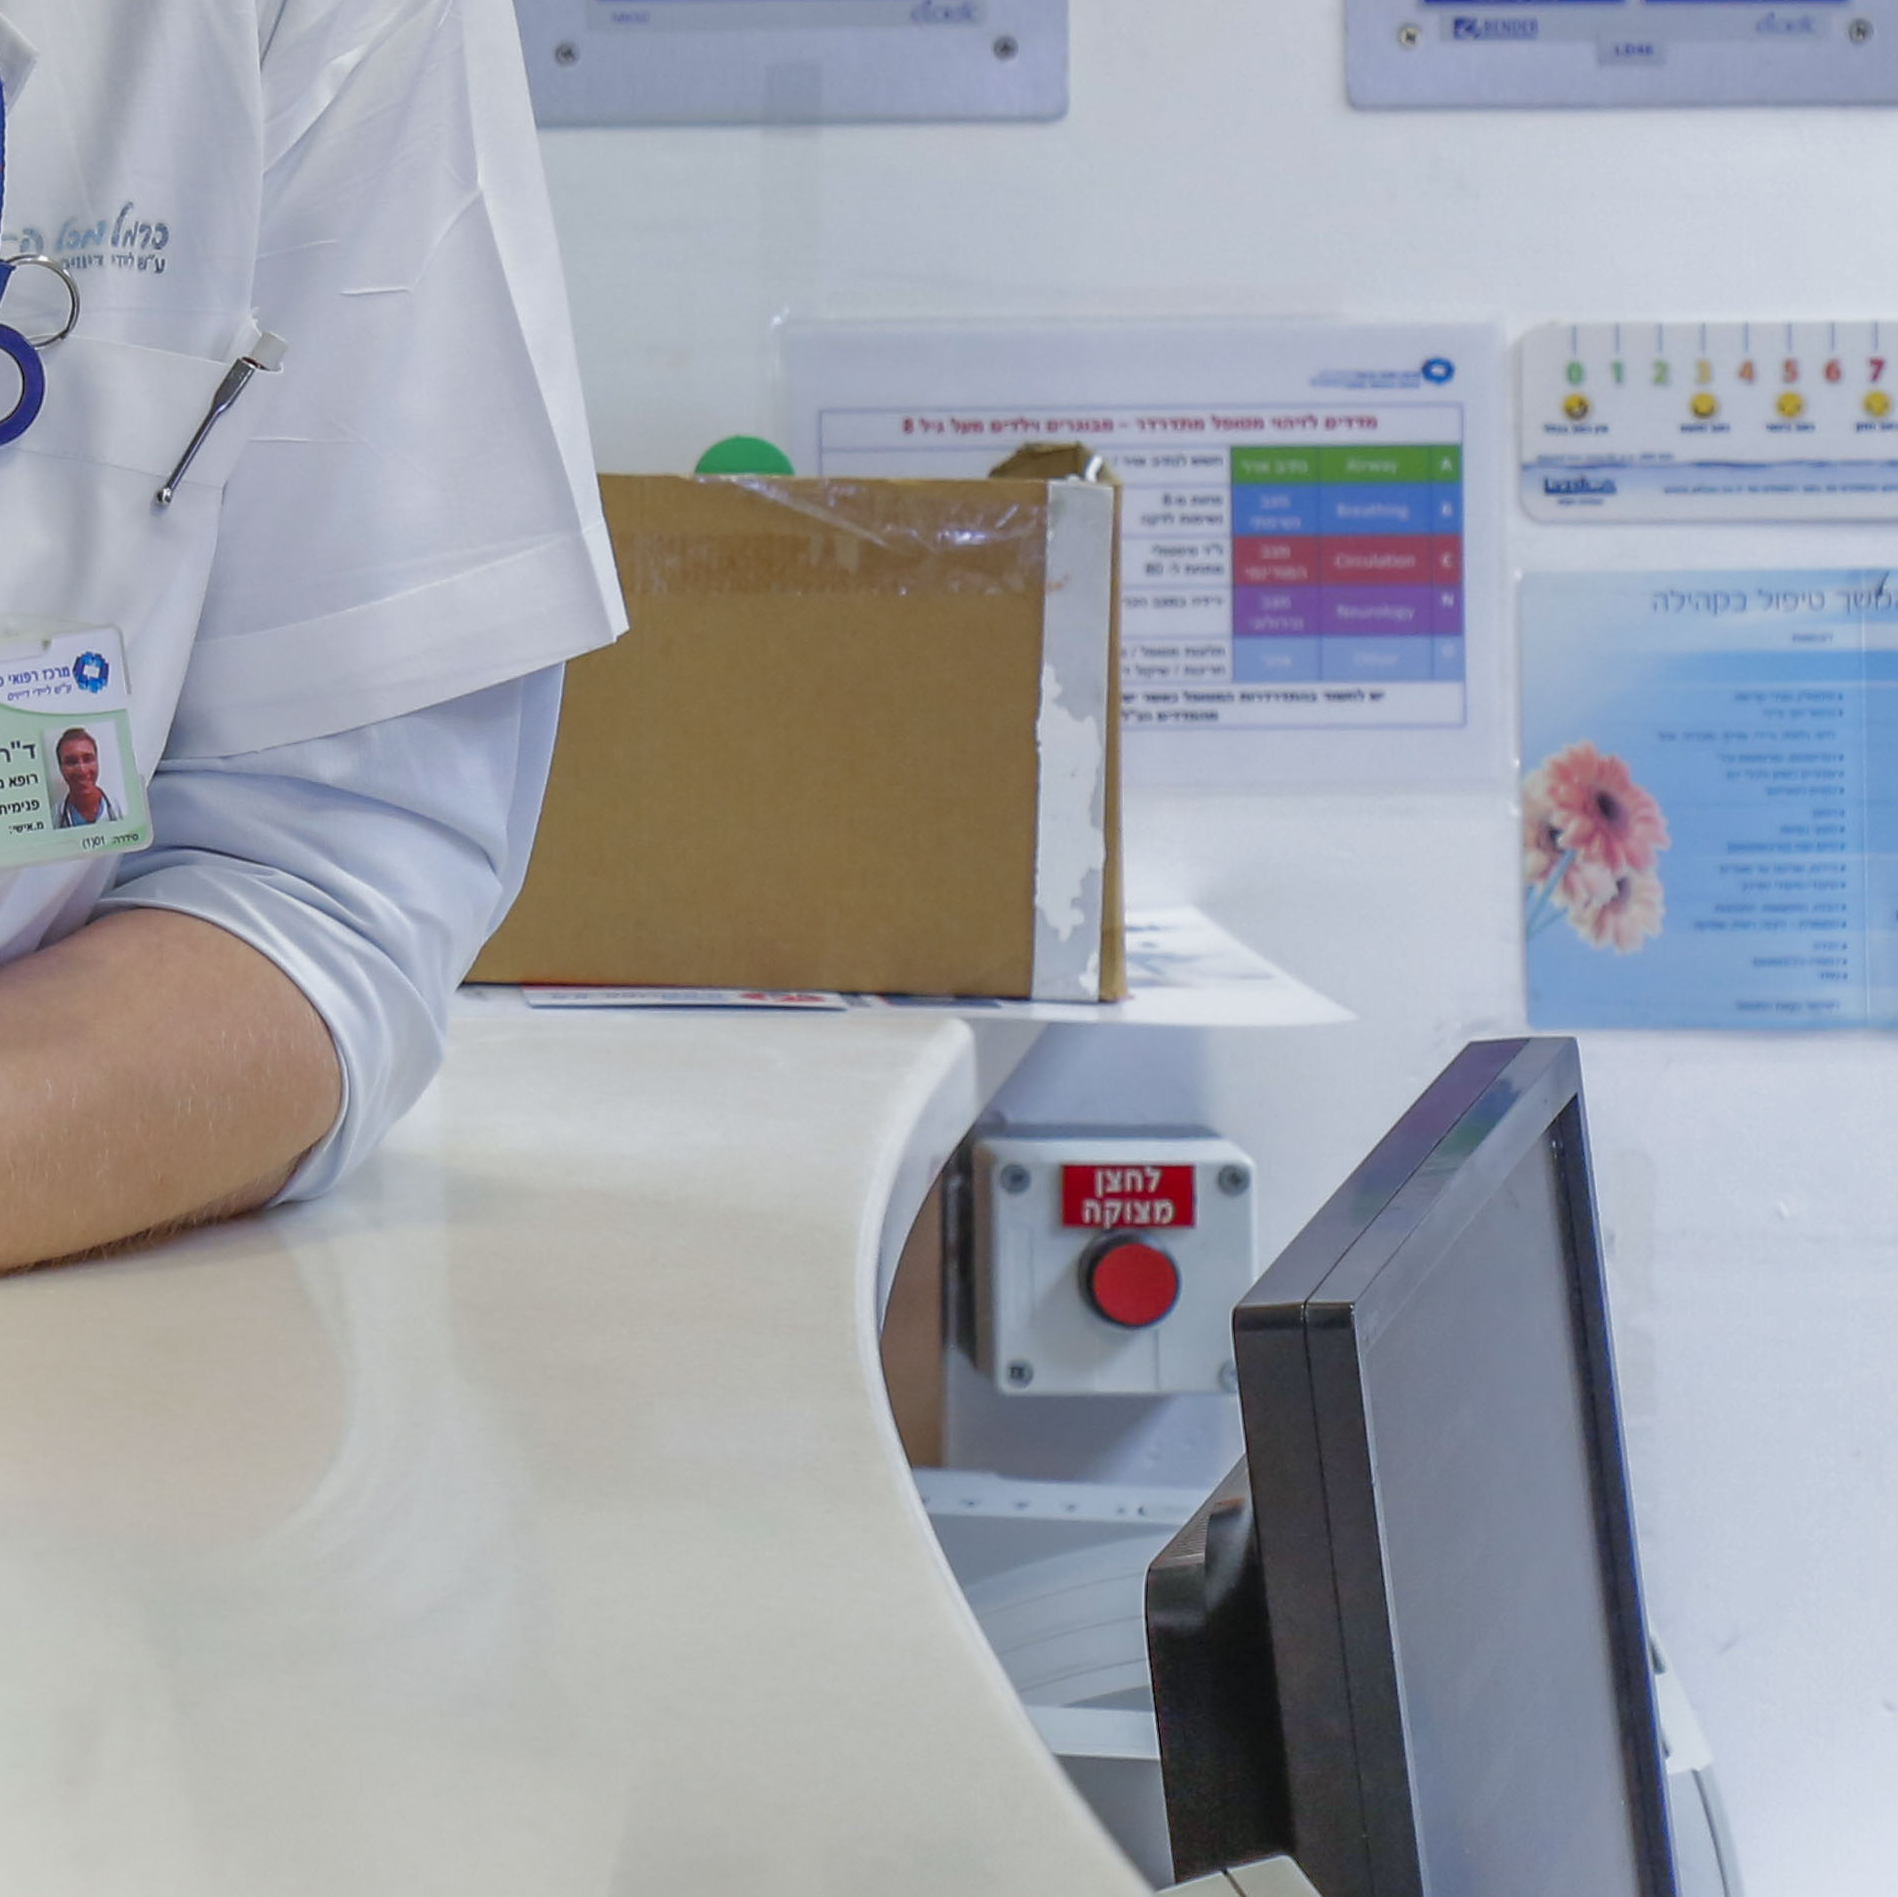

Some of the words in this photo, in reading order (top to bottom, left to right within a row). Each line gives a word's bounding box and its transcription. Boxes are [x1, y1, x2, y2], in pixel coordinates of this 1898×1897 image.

[111, 202, 169, 250] כרמל
[1738, 359, 1755, 384] 4
[1869, 358, 1887, 382] 7
[1333, 552, 1416, 569] Circulation
[1654, 590, 1748, 615] בקהילה
[1757, 589, 1825, 613] טיפול
[9, 670, 39, 685] רפואי
[42, 665, 71, 681] מרכז
[8, 772, 39, 788] רופא
[1094, 1166, 1164, 1197] לחצן
[1082, 1199, 1176, 1229] מצוקה
